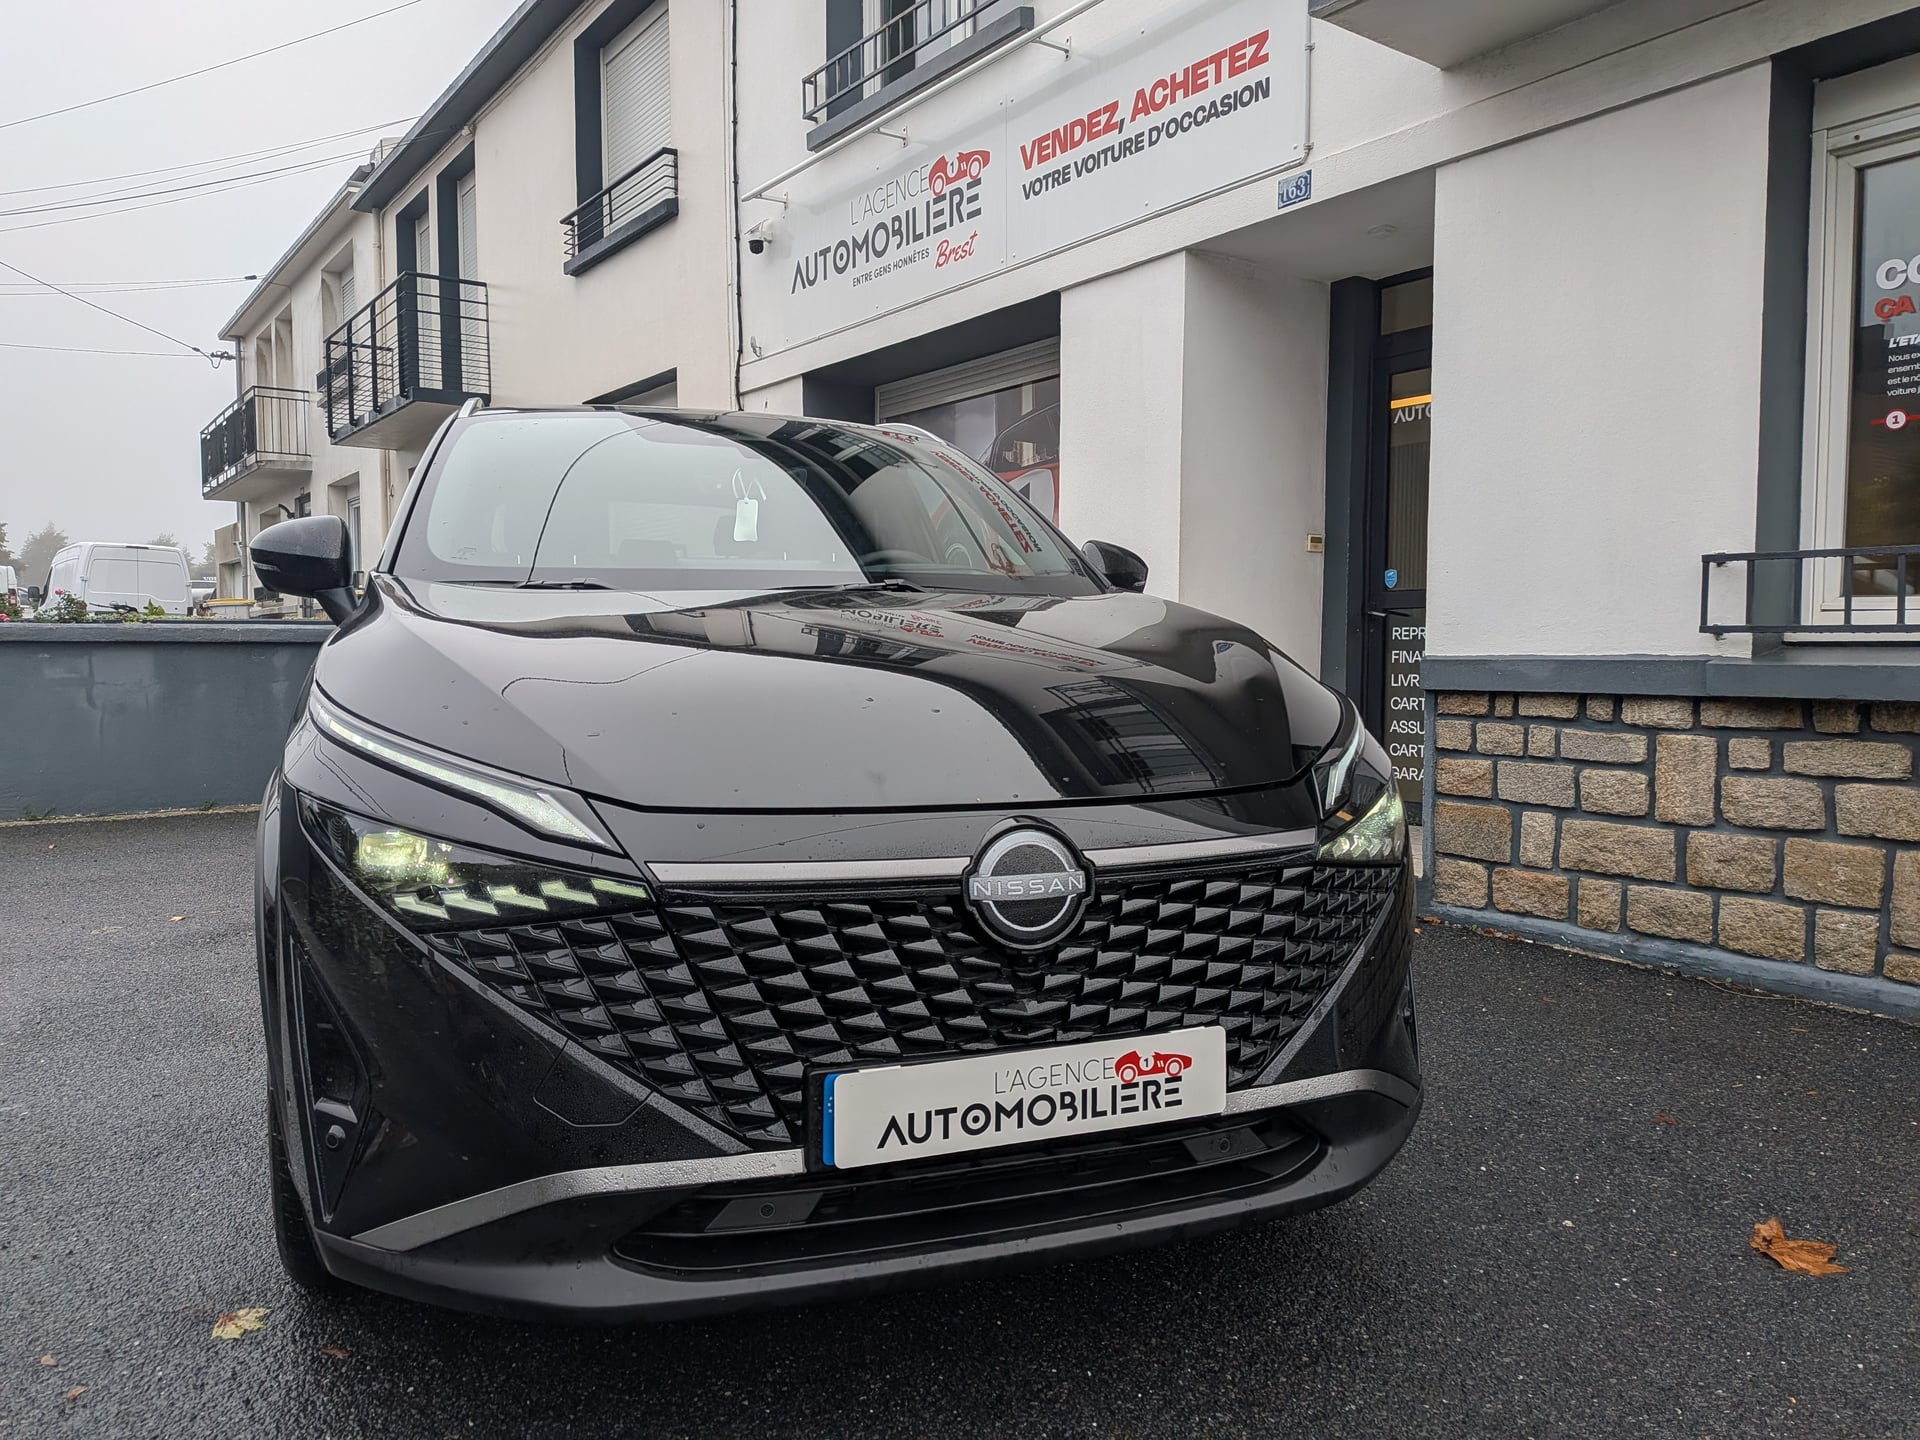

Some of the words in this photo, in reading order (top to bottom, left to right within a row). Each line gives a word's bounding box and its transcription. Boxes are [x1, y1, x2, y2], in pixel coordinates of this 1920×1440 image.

[1020, 100, 1125, 170] VENDEZ,
[1130, 29, 1270, 123] ACHETEZ
[1022, 164, 1071, 201] VOTRE
[1074, 132, 1145, 178] VOITURE
[1148, 77, 1271, 148] D'OCCASION
[850, 164, 930, 225] L'AGENCE
[1282, 177, 1306, 201] 163
[935, 231, 978, 269] Brest
[852, 270, 873, 287] ENTRE
[874, 263, 892, 279] GENS
[893, 247, 930, 272] HONNÊTES
[1888, 354, 1910, 362] Nous
[1887, 387, 1917, 396] voiture
[1391, 674, 1420, 687] LIVR
[1390, 696, 1425, 711] CART
[1389, 743, 1424, 758] CART
[973, 875, 1084, 896] NISSAN
[994, 1057, 1116, 1095] L'AGENCE
